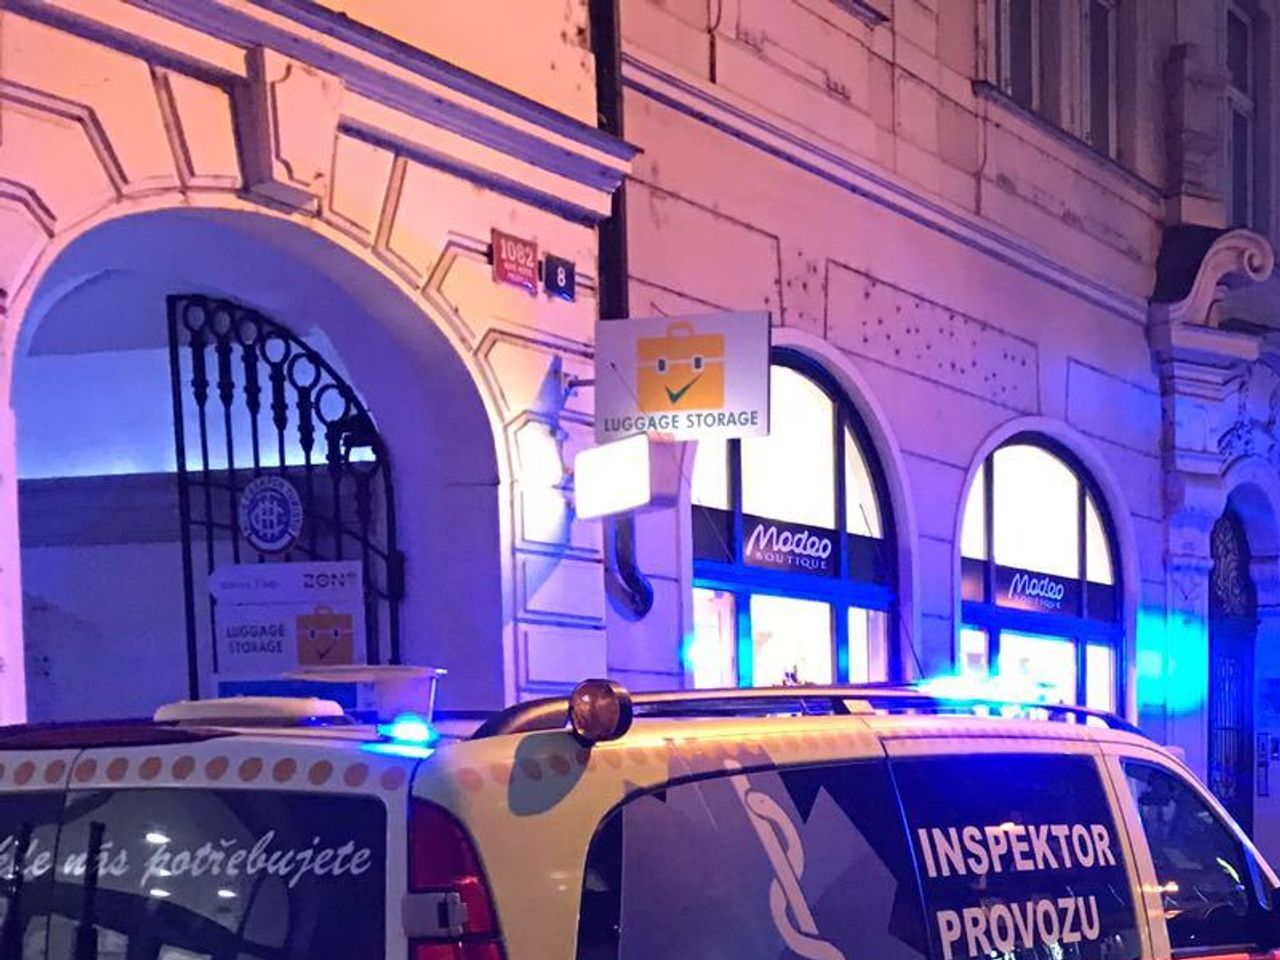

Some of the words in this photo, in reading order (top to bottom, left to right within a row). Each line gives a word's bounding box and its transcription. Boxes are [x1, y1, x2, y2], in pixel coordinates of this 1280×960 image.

[501, 238, 535, 268] 1082
[557, 266, 566, 287] 8
[603, 414, 680, 432] LUGGAGE
[686, 411, 758, 428] STORAGE
[755, 551, 828, 570] BOUTIQUE
[226, 624, 286, 639] LUGGAGE
[228, 639, 284, 654] STORAGE
[140, 830, 372, 889] potřebujete
[918, 823, 1117, 878] INSPEKTOR
